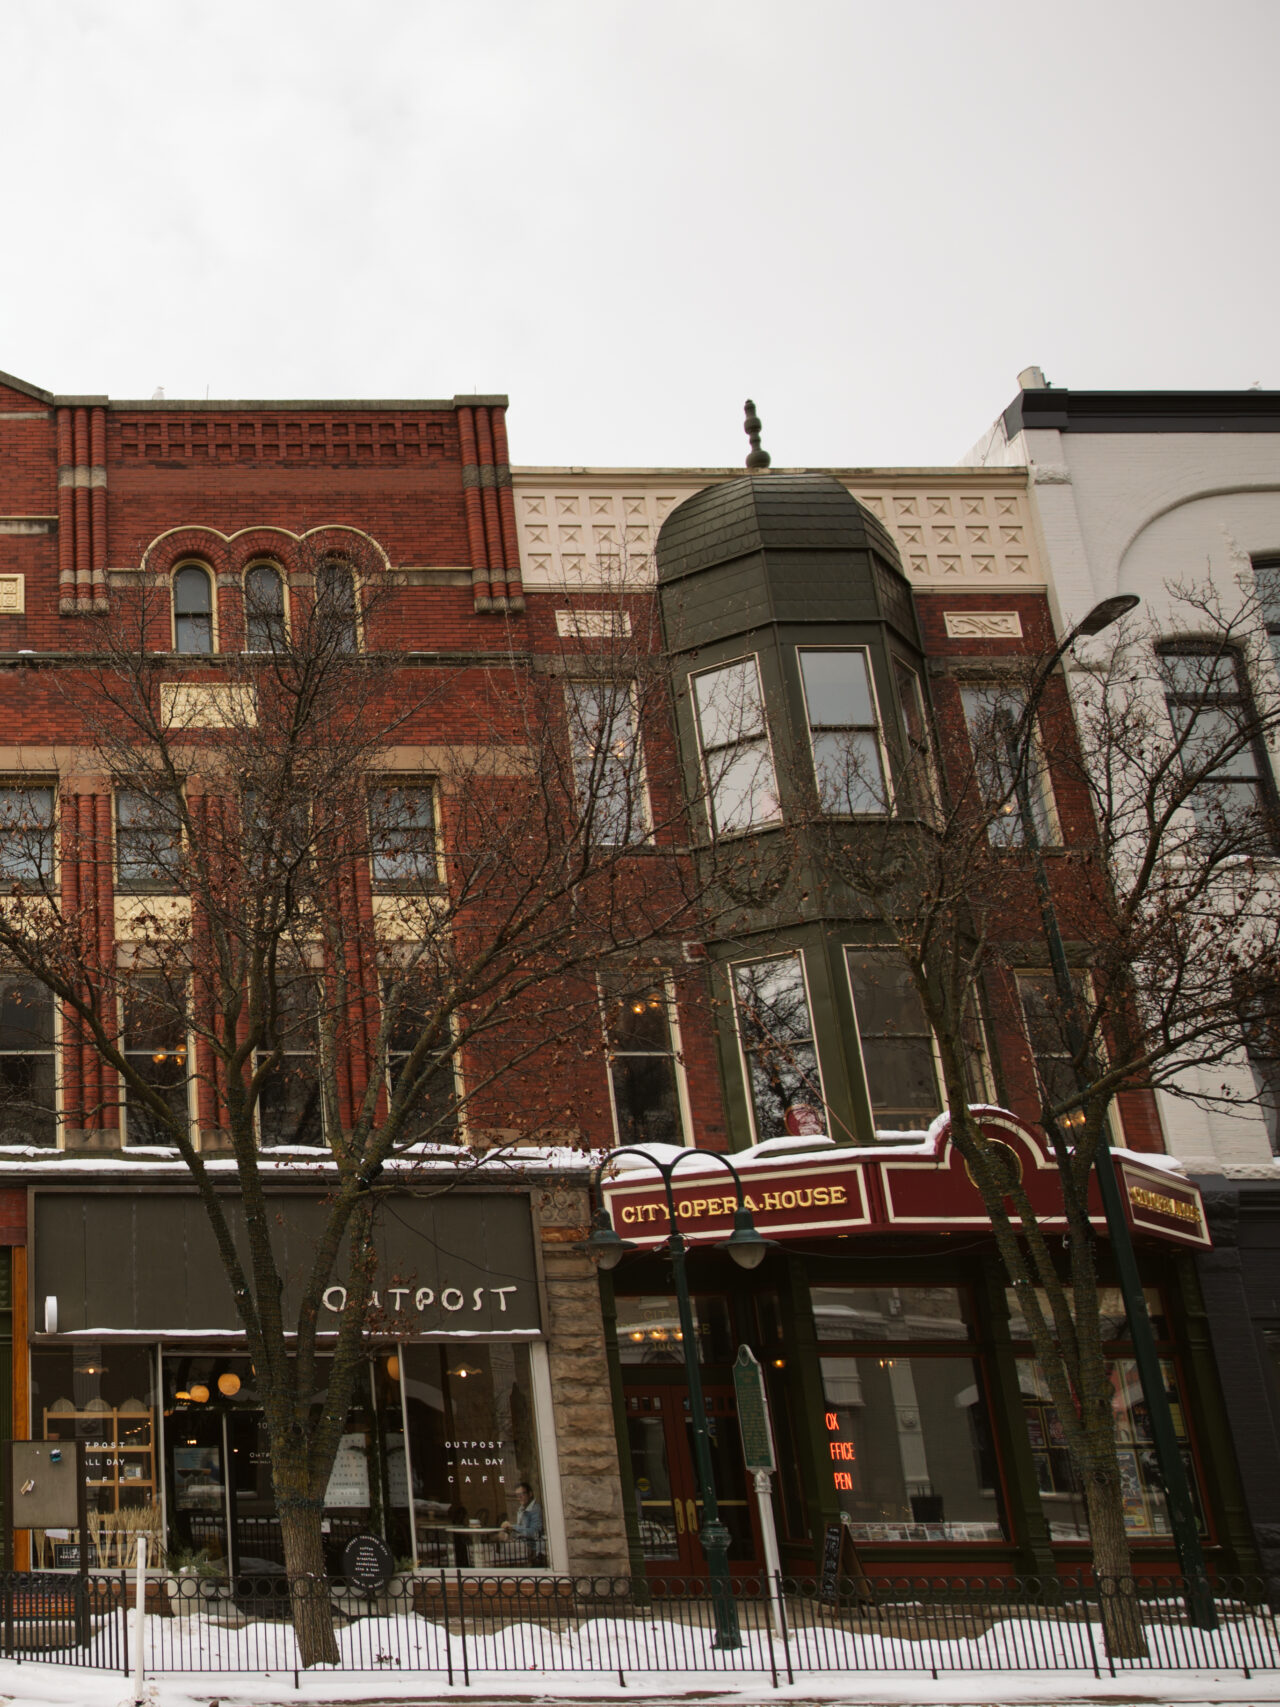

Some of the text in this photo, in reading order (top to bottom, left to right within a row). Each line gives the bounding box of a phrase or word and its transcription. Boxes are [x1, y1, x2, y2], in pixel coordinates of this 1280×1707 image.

[621, 1185, 848, 1224] CITY OPERA HOUSE
[825, 1412, 840, 1431] OX
[85, 1441, 126, 1449] TPOST
[445, 1441, 503, 1449] OUTPOST
[829, 1442, 856, 1460] FFICE
[106, 1458, 125, 1466] DAY
[460, 1458, 480, 1466] ALL
[485, 1458, 504, 1466] DAY
[86, 1476, 125, 1484] AFE
[833, 1472, 853, 1490] PEN
